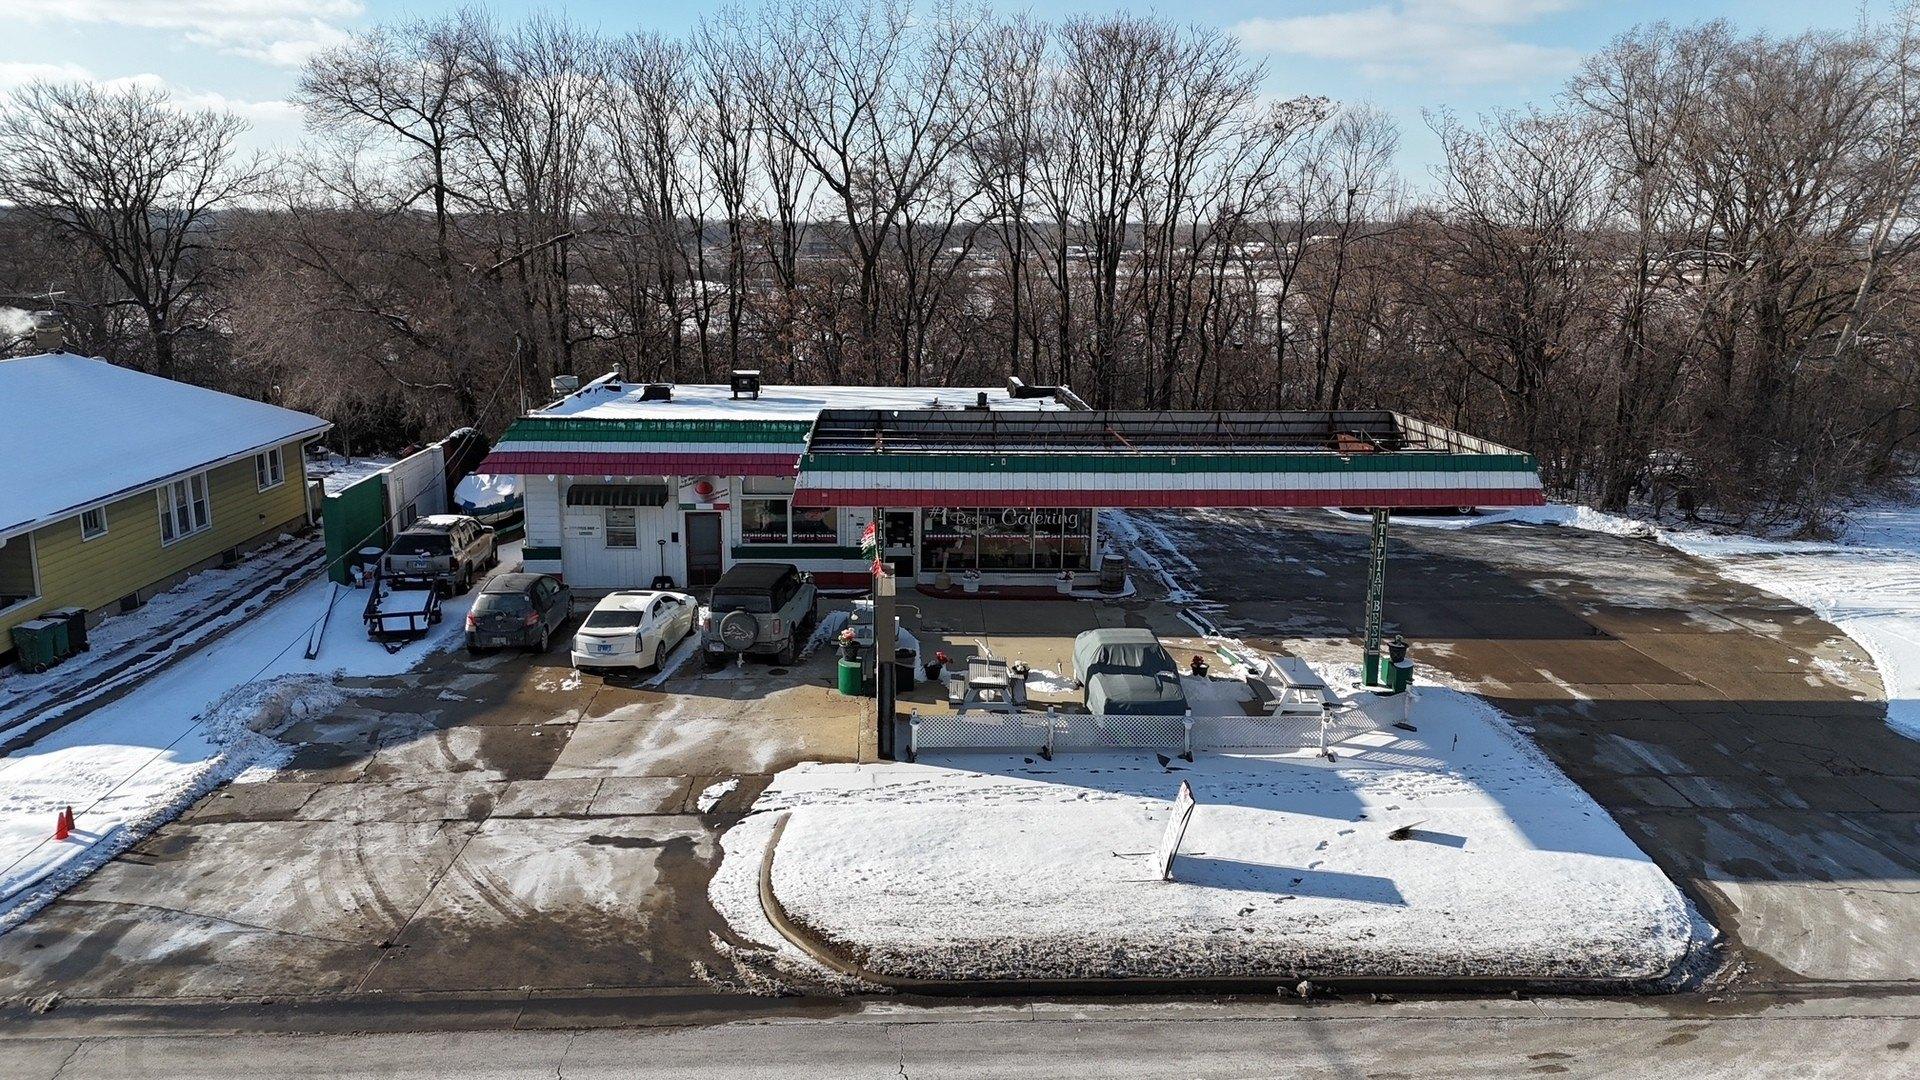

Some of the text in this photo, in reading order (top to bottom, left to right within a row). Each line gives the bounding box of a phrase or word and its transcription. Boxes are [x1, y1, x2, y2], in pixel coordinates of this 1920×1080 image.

[928, 507, 947, 525] #1
[950, 511, 983, 525] Best
[1001, 508, 1079, 529] Catering
[1371, 511, 1386, 649] ITALIAN BEEF
